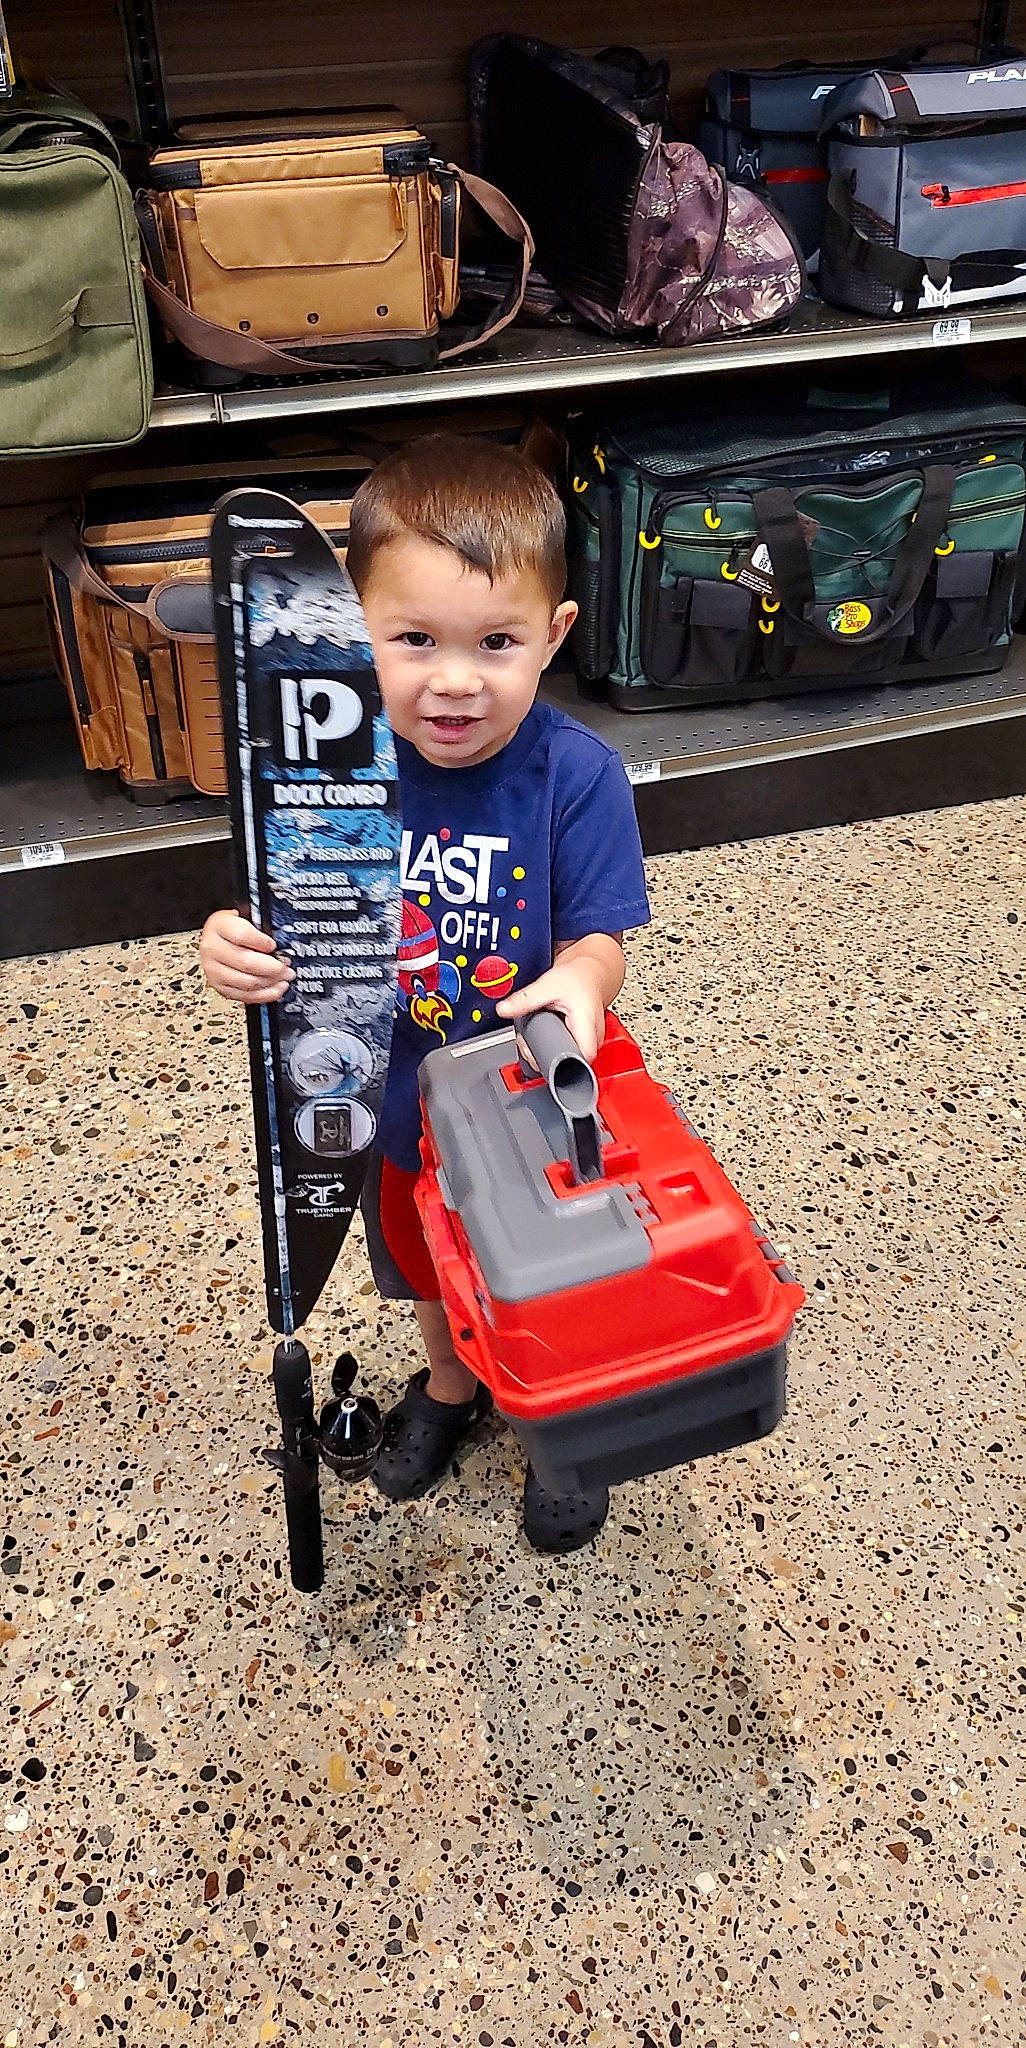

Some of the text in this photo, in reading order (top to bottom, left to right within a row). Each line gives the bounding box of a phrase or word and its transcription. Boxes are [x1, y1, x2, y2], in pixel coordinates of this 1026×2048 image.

[967, 67, 1026, 84] PLA
[844, 603, 862, 614] Bass
[846, 620, 866, 629] Shops
[273, 783, 388, 806] DOCK COMBO
[293, 921, 319, 934] SOFT
[440, 909, 501, 951] OFF!
